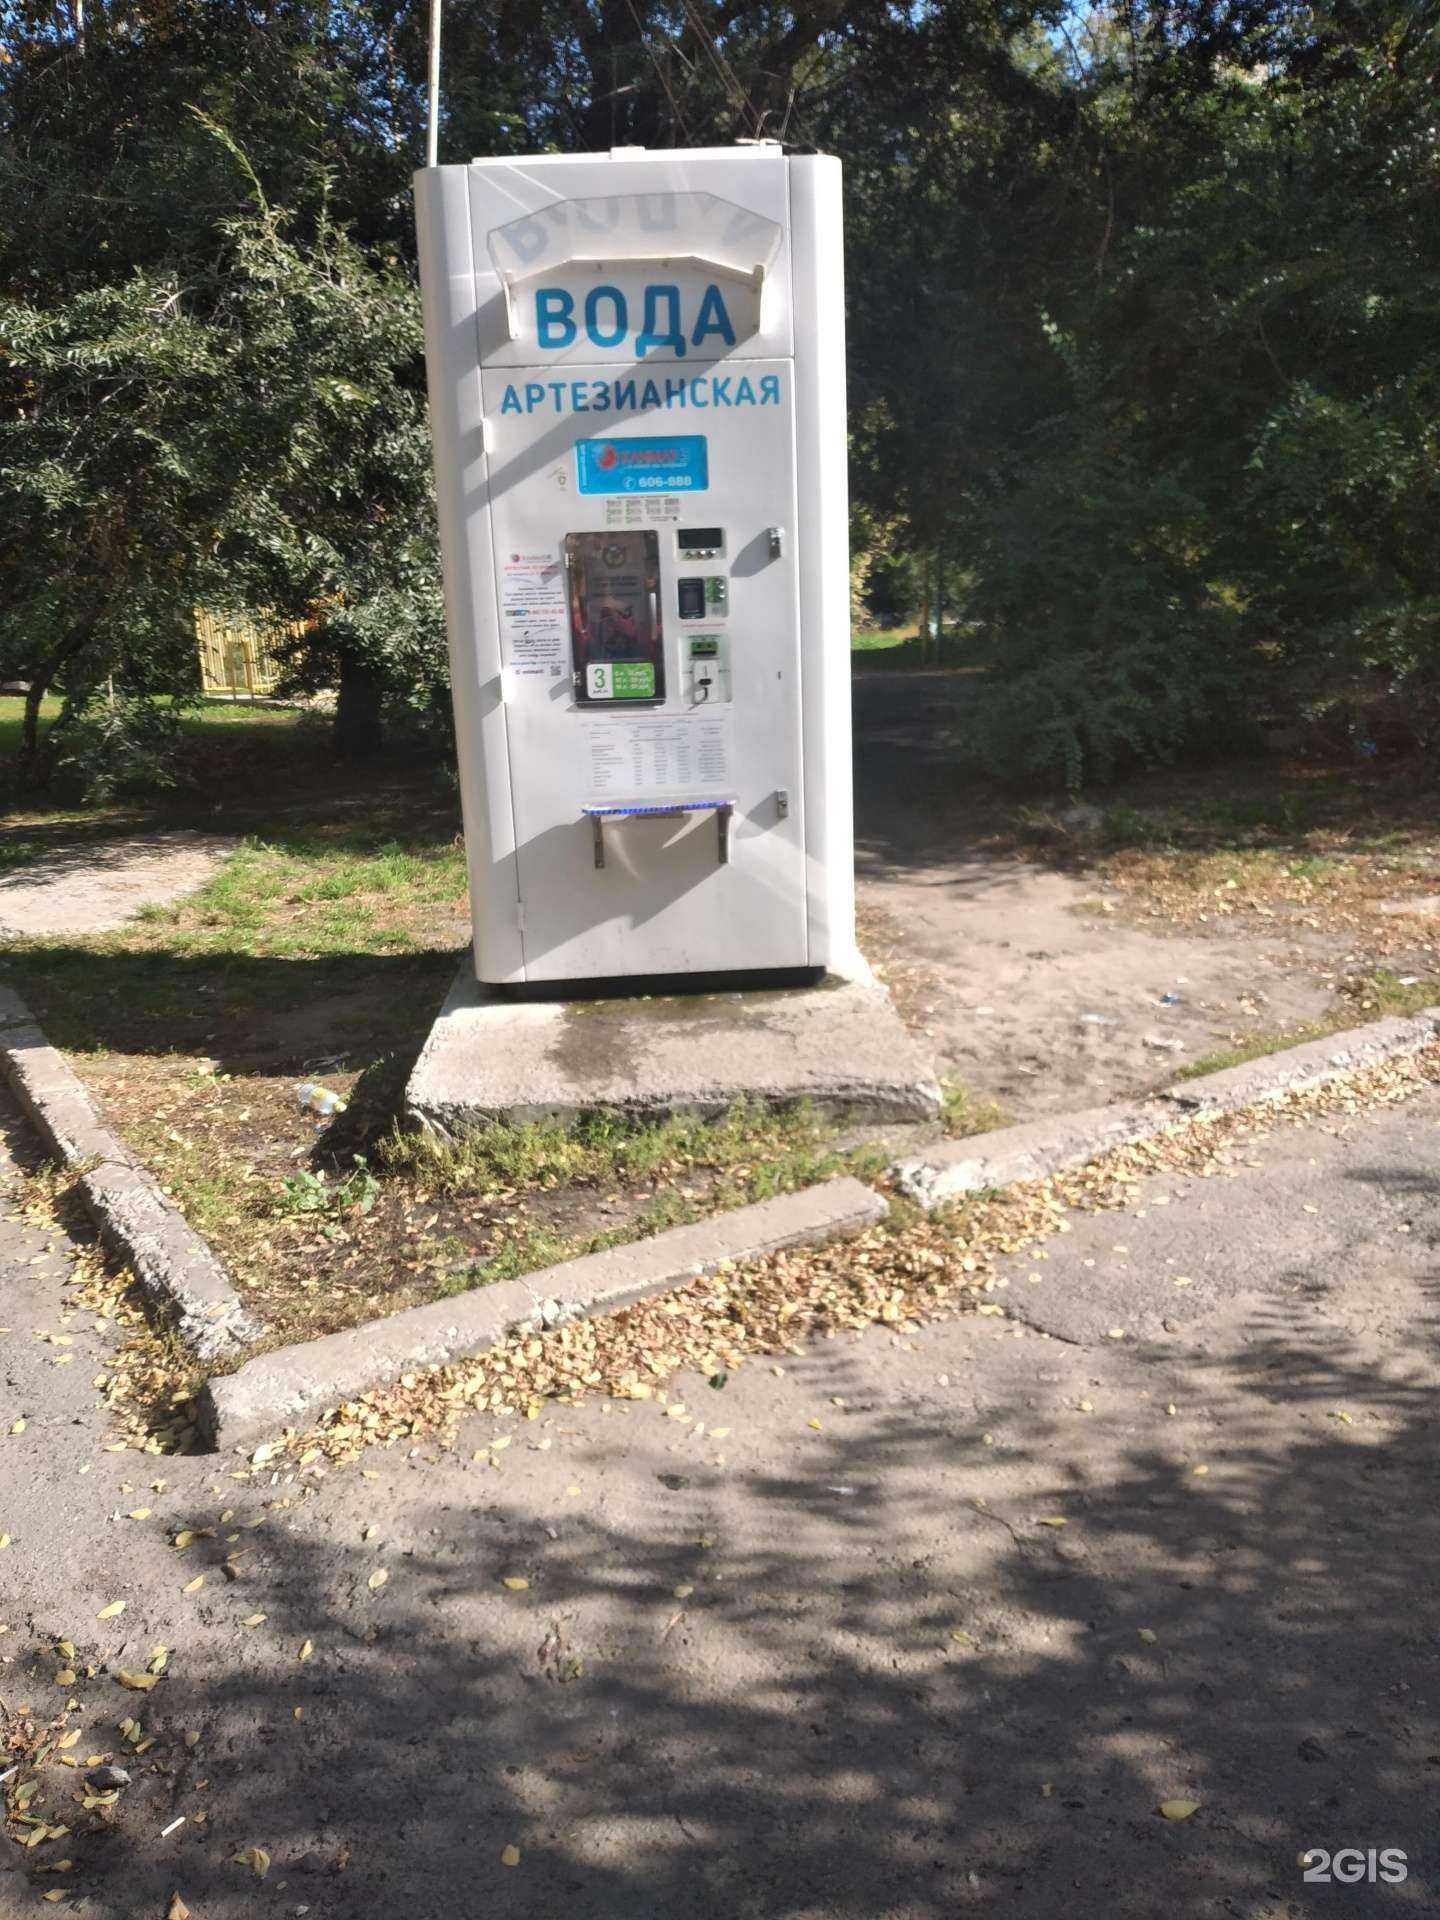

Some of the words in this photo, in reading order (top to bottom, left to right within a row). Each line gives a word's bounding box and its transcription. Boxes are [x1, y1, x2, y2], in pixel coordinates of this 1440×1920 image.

[535, 284, 736, 358] ВОДА
[501, 375, 780, 415] АРТЕЗИАНСКАЯ
[594, 668, 606, 688] 3
